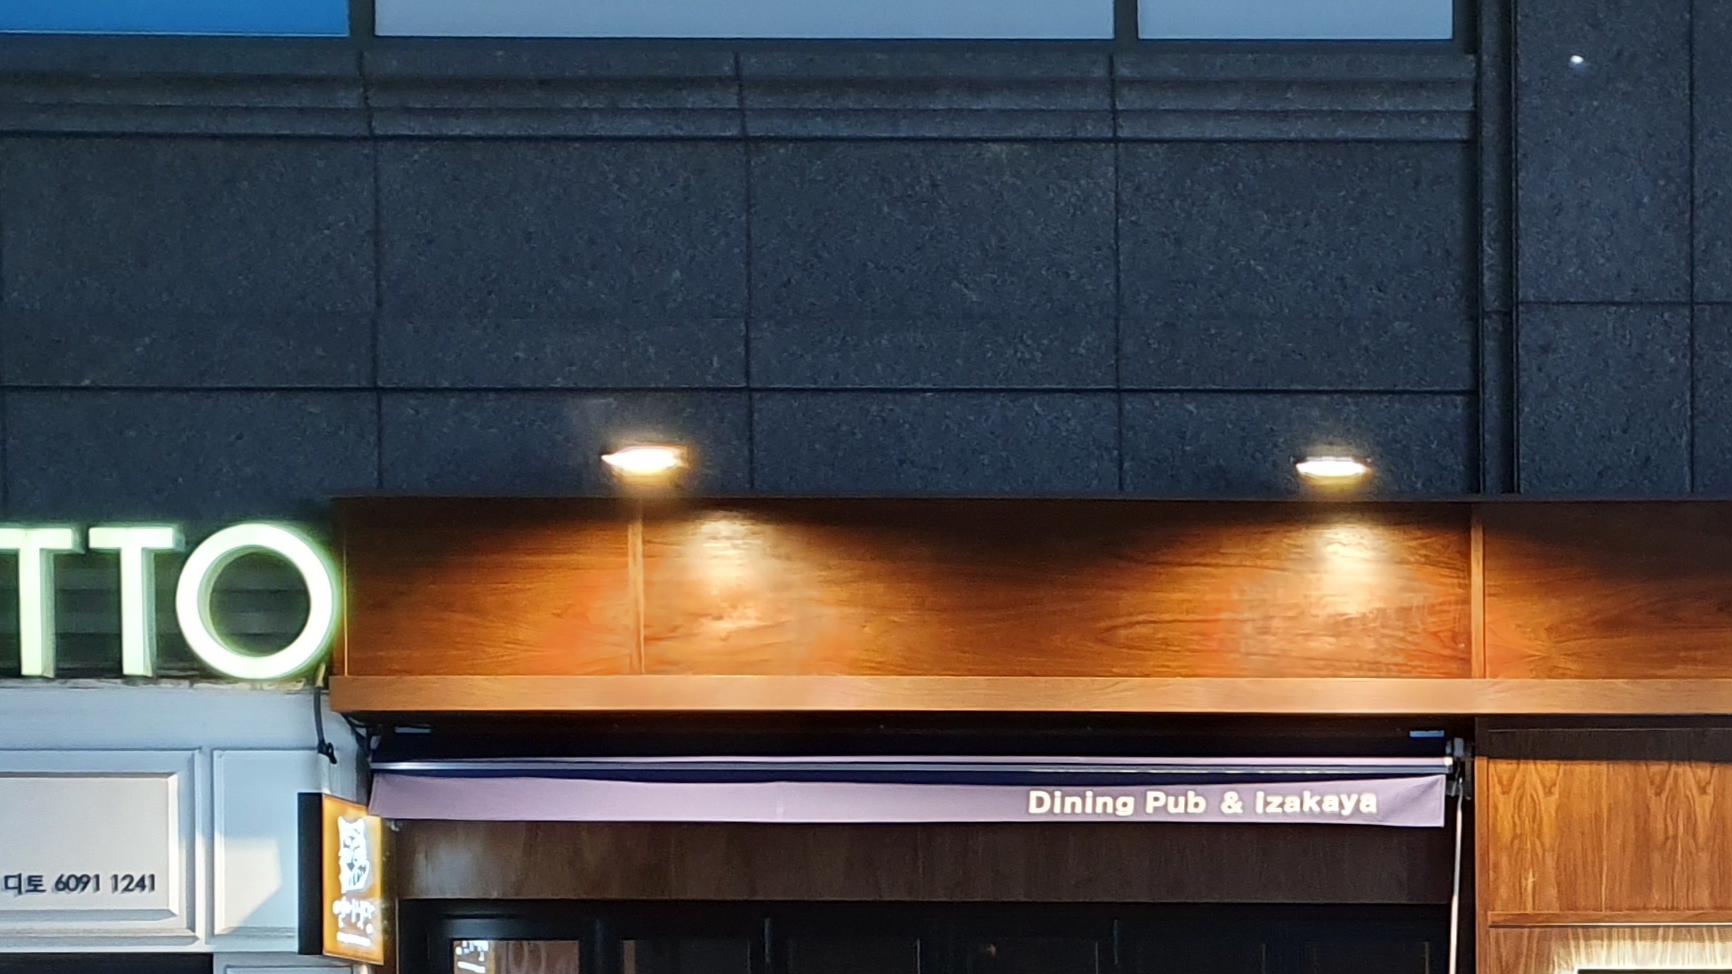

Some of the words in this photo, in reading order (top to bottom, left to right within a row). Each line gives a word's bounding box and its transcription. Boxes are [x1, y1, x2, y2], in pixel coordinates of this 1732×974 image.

[0, 523, 335, 679] TTO
[1027, 790, 1135, 817] Dining
[1145, 790, 1207, 814] Pub
[1220, 790, 1244, 814] &
[1255, 790, 1378, 816] Izakaya
[3, 873, 47, 895] 디토
[54, 873, 101, 892] 6091
[110, 873, 156, 893] 1241
